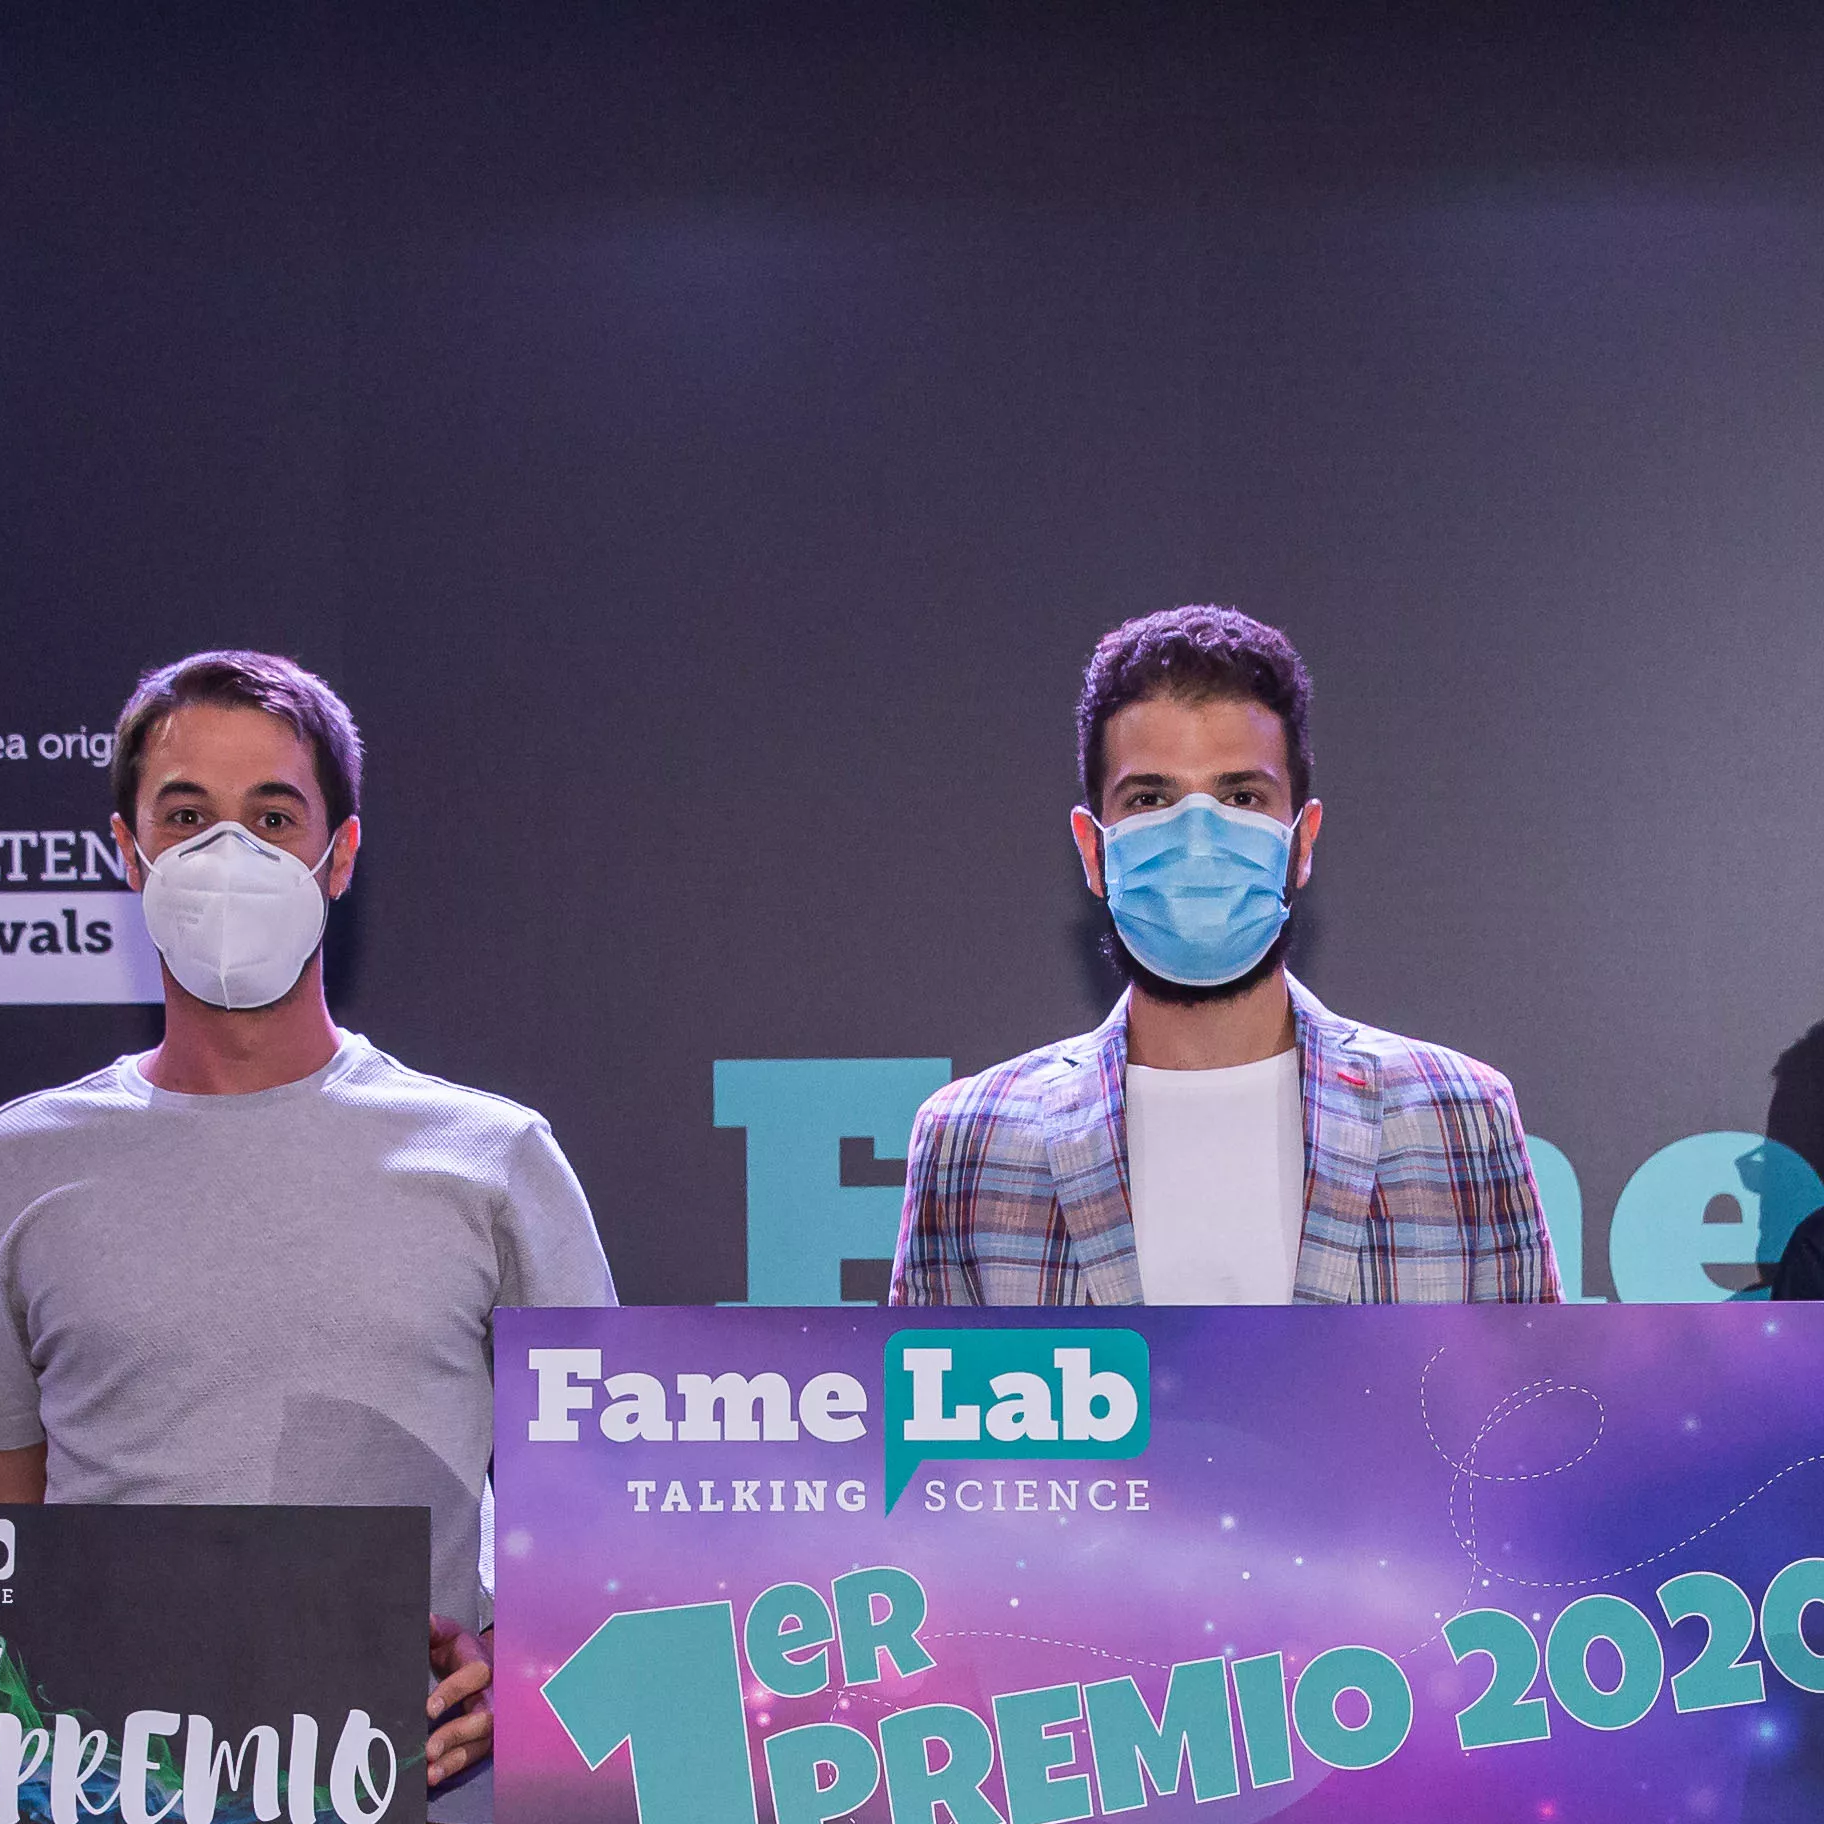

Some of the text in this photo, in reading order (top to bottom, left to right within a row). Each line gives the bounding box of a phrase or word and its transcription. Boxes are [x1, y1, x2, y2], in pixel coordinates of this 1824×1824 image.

[528, 1348, 1138, 1443] Fame Lab
[627, 1479, 1150, 1512] TALKING SCIENCE
